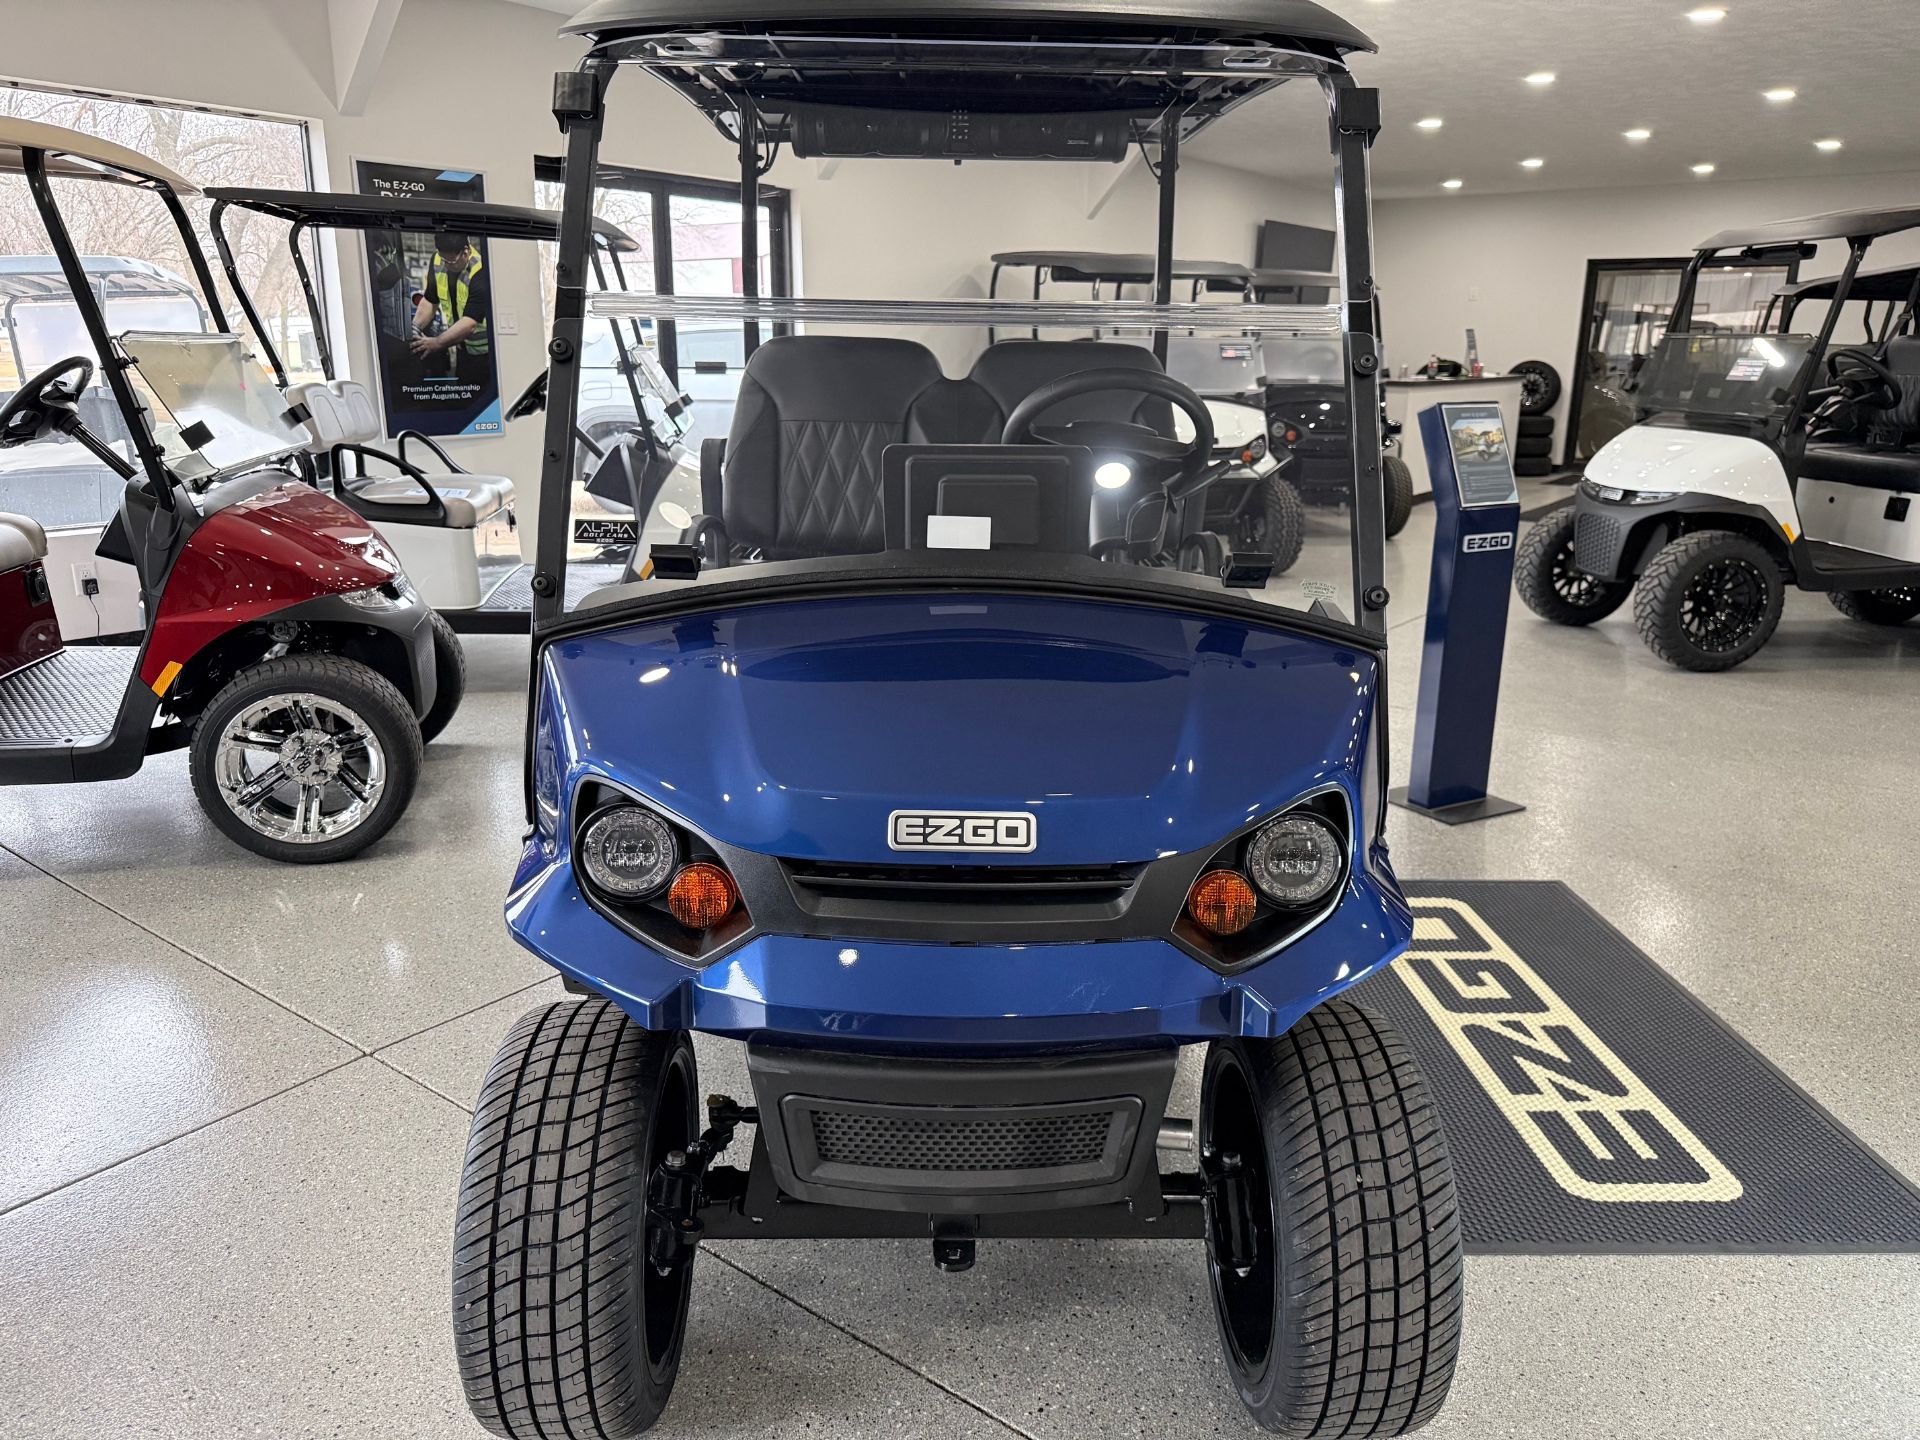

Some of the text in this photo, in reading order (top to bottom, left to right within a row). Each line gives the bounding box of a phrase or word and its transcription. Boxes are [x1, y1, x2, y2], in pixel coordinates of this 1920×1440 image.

[372, 178, 425, 192] The E-Z-GO
[402, 384, 481, 393] Premium Craftsmanship
[431, 392, 461, 401] Augusta,
[575, 522, 636, 539] ALPHA
